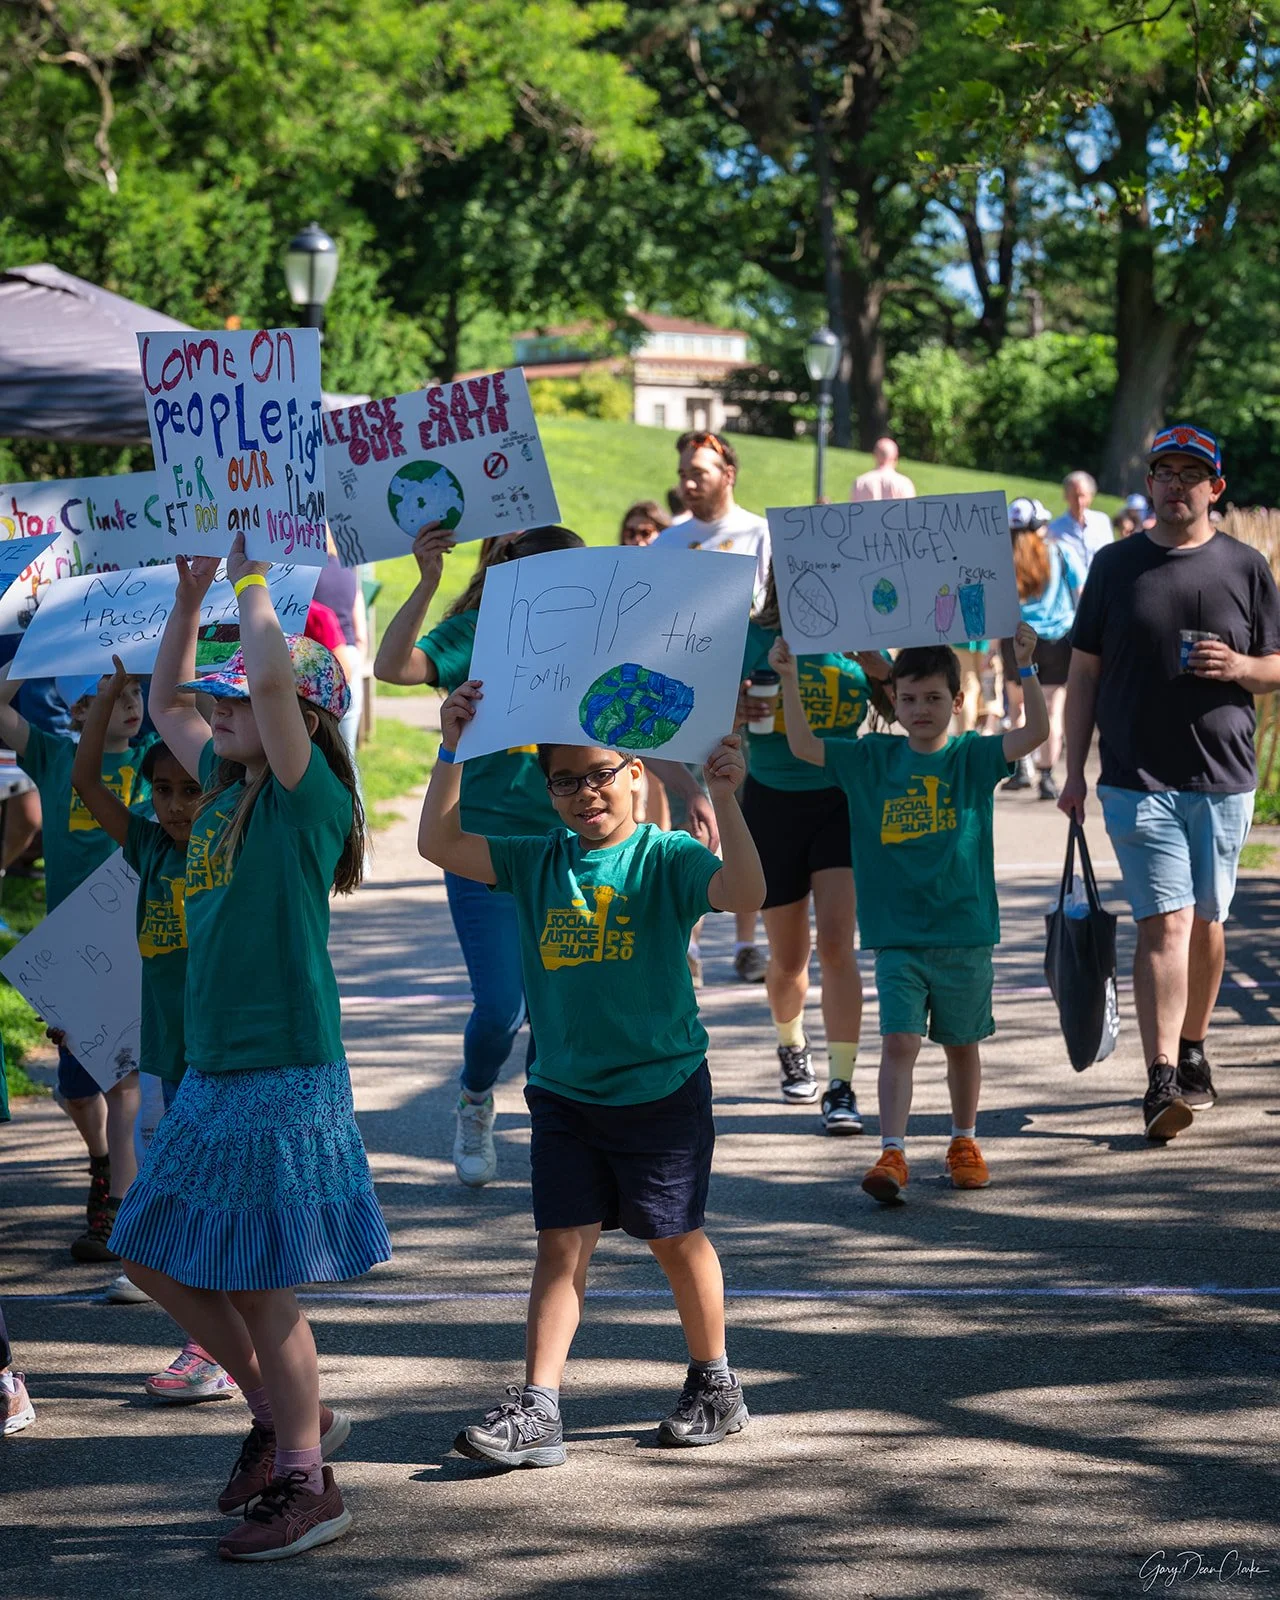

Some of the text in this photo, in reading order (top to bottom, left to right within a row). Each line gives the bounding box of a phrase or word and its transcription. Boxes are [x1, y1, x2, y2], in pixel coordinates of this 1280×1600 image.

[427, 371, 510, 421] SAVE
[348, 406, 509, 466] OUR EARTH
[784, 500, 1005, 541] STOP CLIMATE
[837, 530, 958, 563] CHANGE!
[84, 571, 146, 606] No
[507, 560, 712, 657] help the
[100, 624, 163, 647] sea!
[507, 664, 571, 715] Earth
[889, 800, 932, 812] SOCIAL
[882, 811, 932, 826] JUSTICE
[938, 819, 957, 831] 20
[901, 822, 932, 833] RUN
[547, 914, 600, 929] SOCIAL
[541, 929, 599, 946] JUSTICE
[605, 930, 636, 945] PS
[558, 944, 599, 959] RUN
[604, 945, 634, 960] 20
